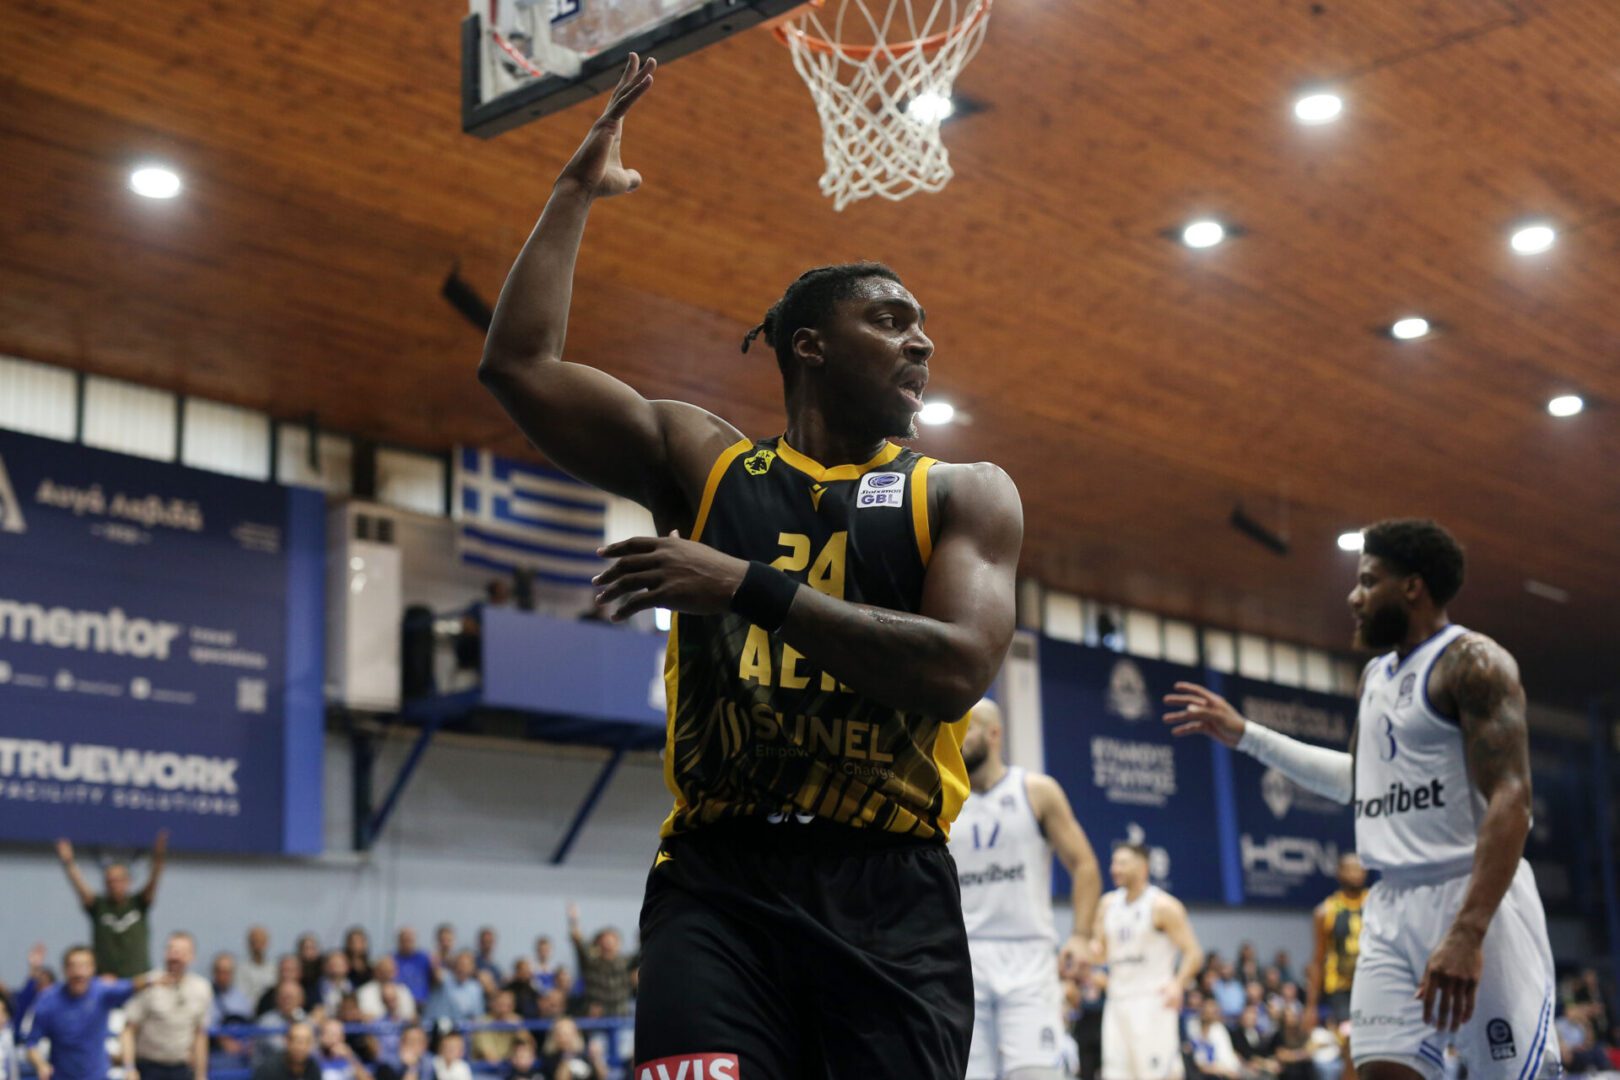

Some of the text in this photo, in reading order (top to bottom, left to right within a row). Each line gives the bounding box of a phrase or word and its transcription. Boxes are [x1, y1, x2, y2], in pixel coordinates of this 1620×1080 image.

[861, 494, 899, 505] GBL
[769, 531, 848, 600] 24
[0, 600, 180, 660] mentor
[739, 624, 854, 693] AE
[0, 737, 239, 794] TRUEWORK
[1378, 714, 1397, 762] 3
